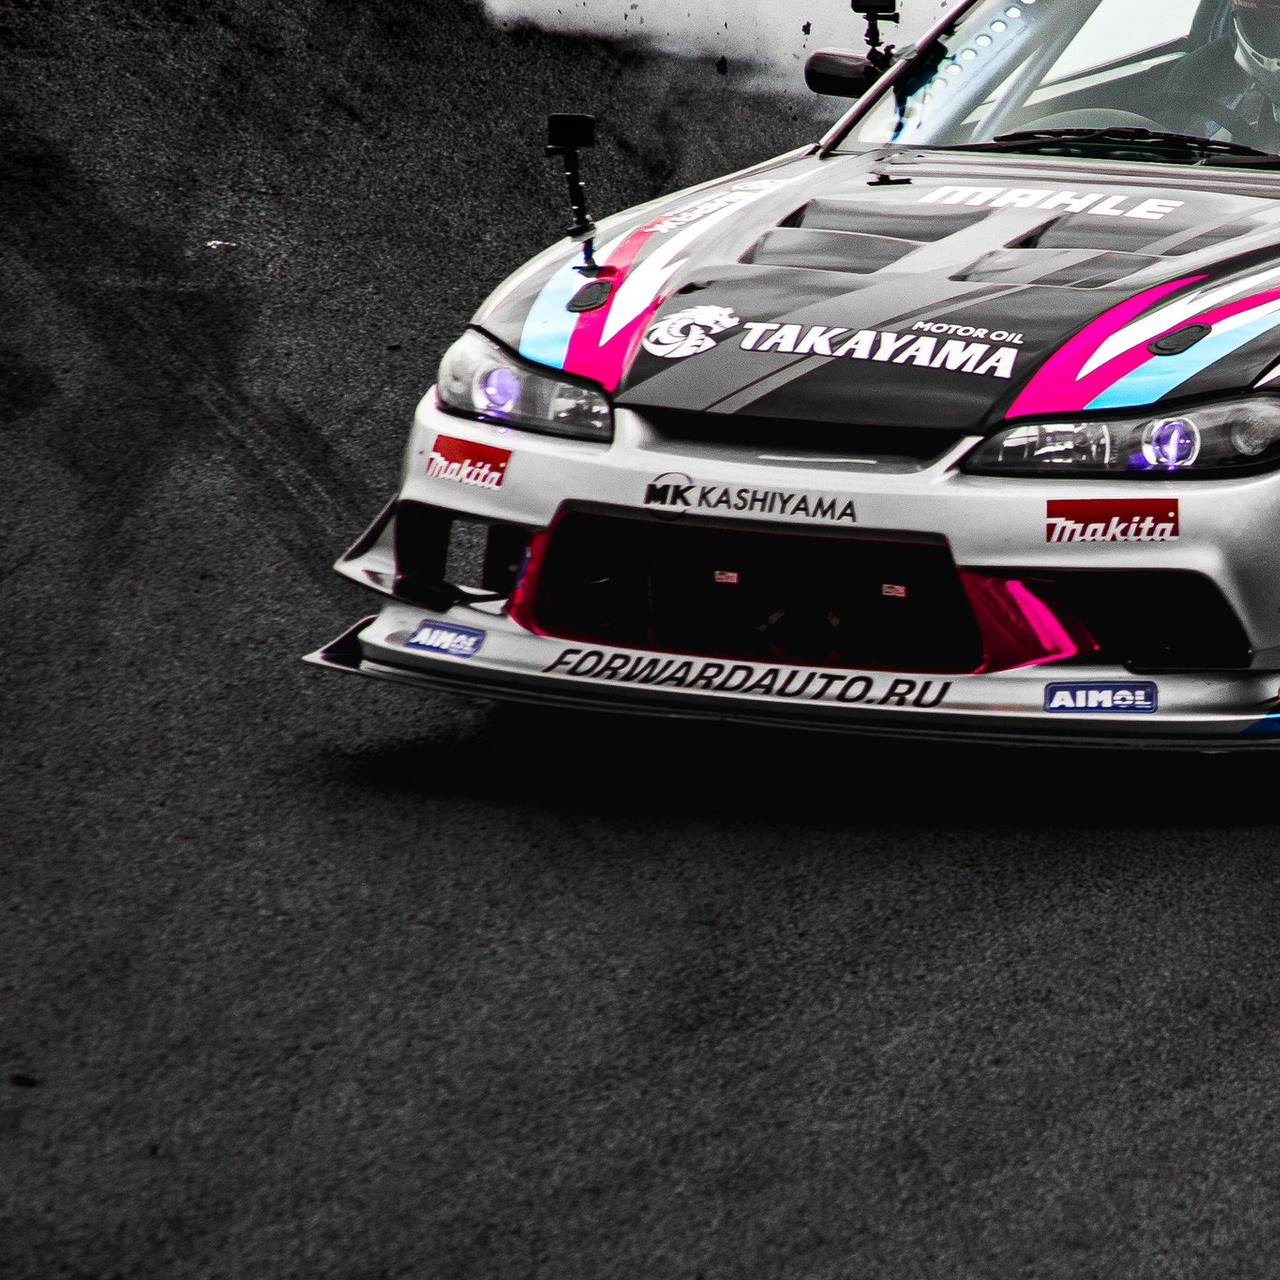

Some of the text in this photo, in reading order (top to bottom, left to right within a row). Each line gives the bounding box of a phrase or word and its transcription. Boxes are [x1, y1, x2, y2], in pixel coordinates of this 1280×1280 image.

[918, 185, 1185, 220] MAHLE
[740, 321, 1019, 379] TAKAYAMA
[911, 320, 1025, 345] MOTOR OIL
[644, 482, 858, 523] MK KASHIYAMA
[542, 647, 954, 709] FORWARDAUTO.RU
[1049, 689, 1152, 709] AIMOL
